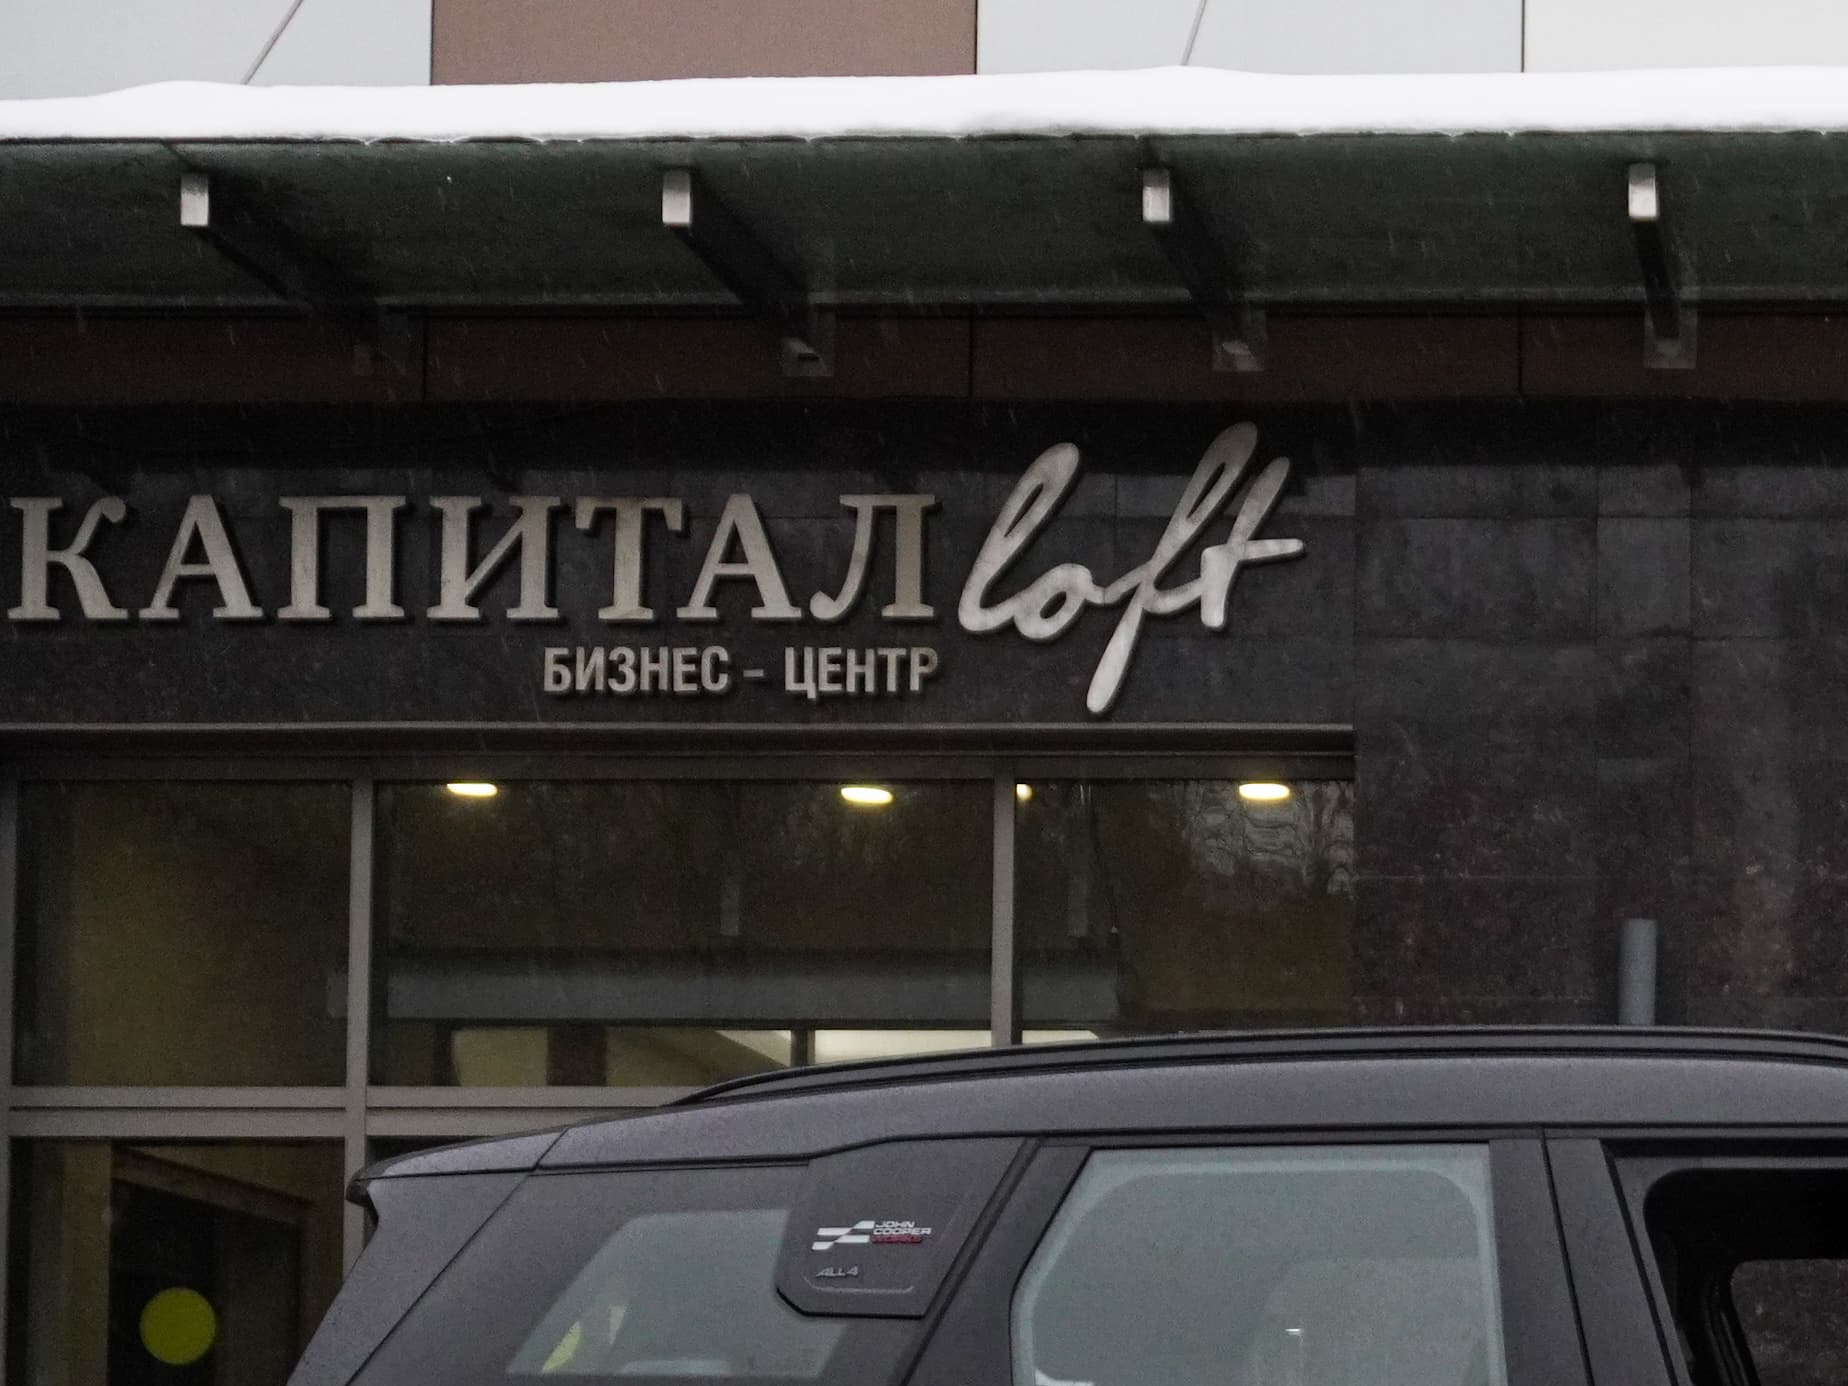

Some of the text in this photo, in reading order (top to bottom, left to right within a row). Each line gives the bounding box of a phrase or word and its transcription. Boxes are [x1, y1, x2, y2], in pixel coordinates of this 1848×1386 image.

[7, 421, 1304, 713] КАПИТАЛ loft
[543, 646, 729, 693] БИЗНЕС
[784, 646, 938, 699] ЦЕНТР
[875, 1220, 915, 1228] JOHN
